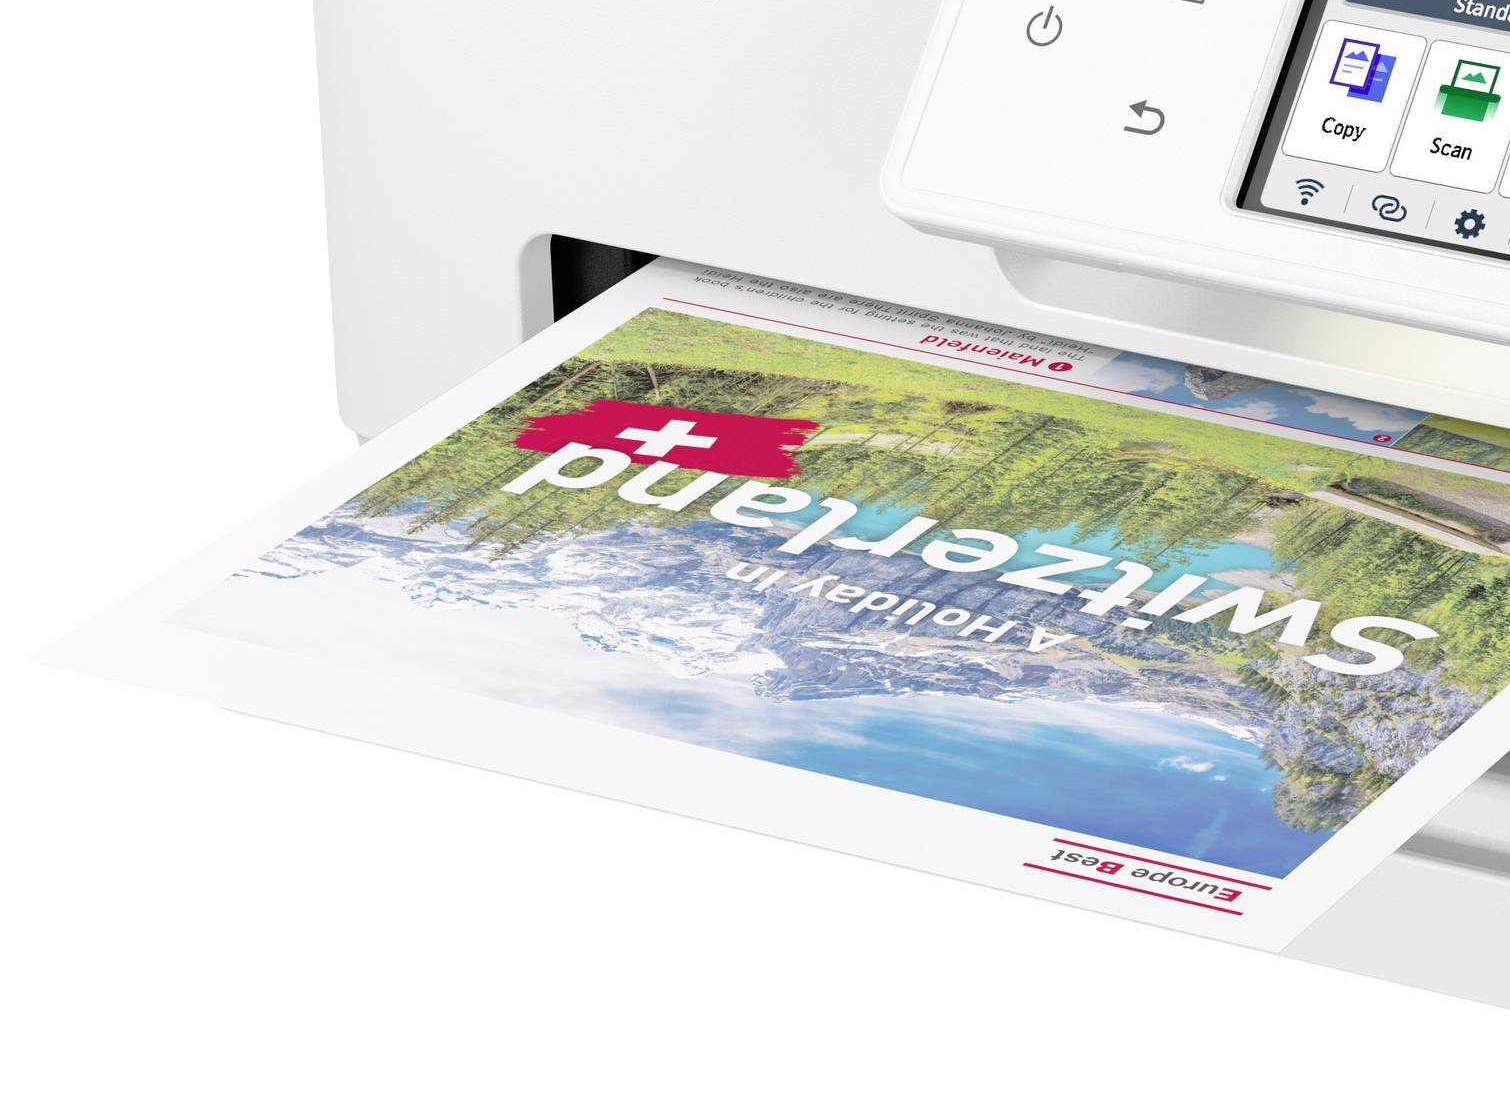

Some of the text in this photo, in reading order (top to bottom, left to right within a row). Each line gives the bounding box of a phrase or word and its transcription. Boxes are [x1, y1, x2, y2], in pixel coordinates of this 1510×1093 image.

[1321, 116, 1367, 142] Copy
[1429, 137, 1473, 160] Scan
[779, 284, 813, 295] also
[817, 293, 844, 302] are
[694, 276, 1086, 361] The land that was the setting for the children's book
[945, 318, 1008, 337] Johanna
[920, 334, 1045, 367] Maienfeld
[1017, 332, 1035, 343] by
[500, 441, 1440, 677] Switzerland
[789, 574, 1018, 643] Holiday
[1025, 626, 1080, 652] A
[1050, 849, 1243, 902] Europe Best
